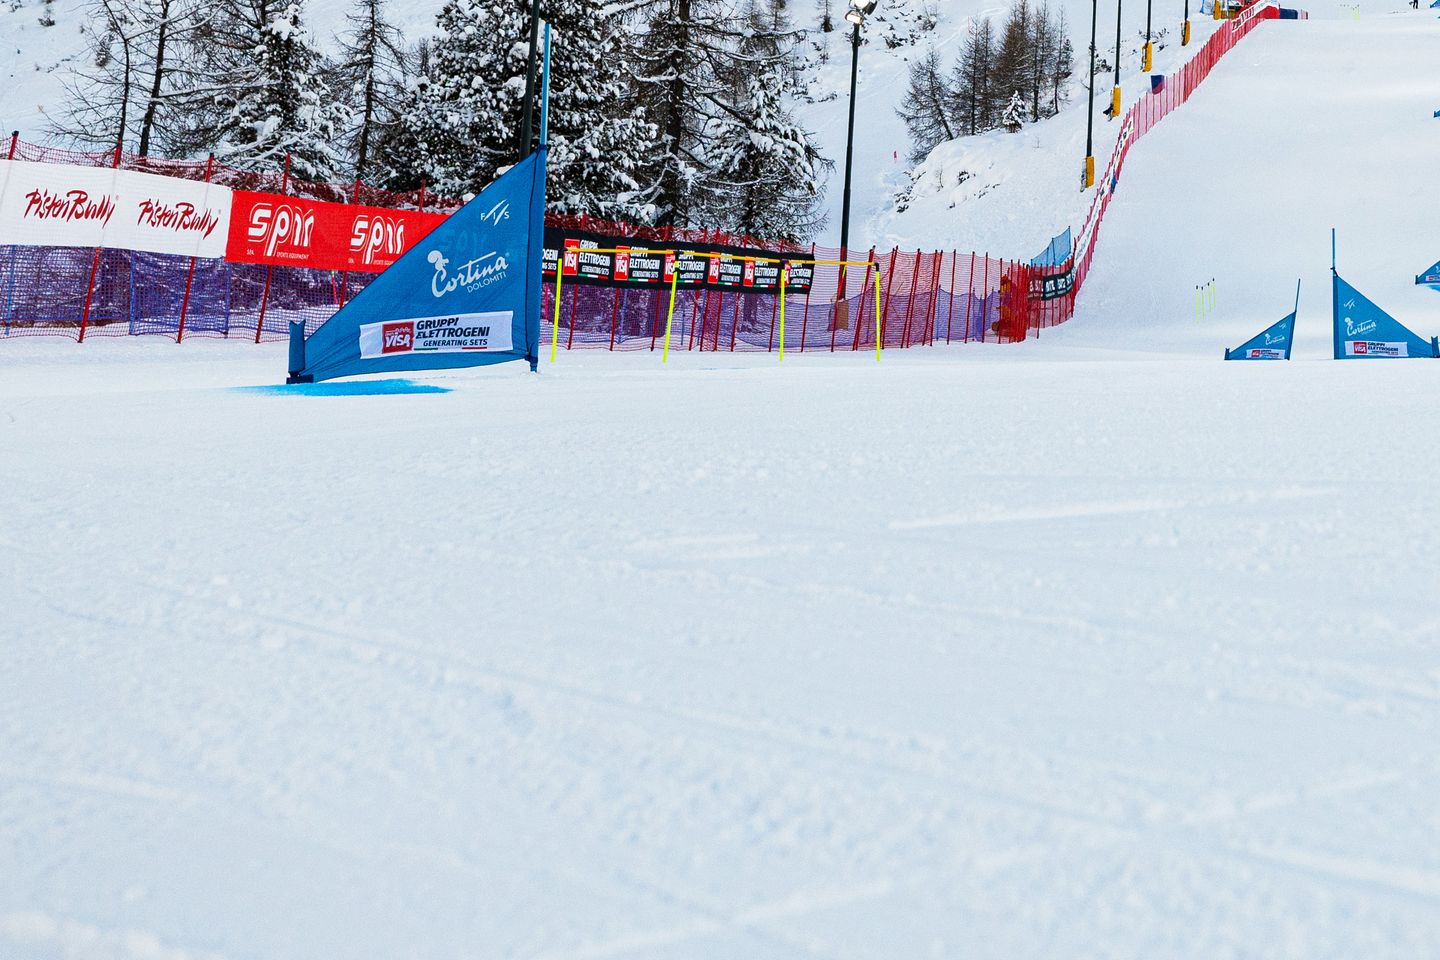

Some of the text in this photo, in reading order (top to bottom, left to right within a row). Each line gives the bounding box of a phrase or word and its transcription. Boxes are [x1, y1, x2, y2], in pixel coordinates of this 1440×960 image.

[24, 188, 115, 229] PistenBully
[138, 198, 219, 240] PistenBully
[578, 252, 611, 267] ELETTROGENI
[629, 258, 661, 270] ELETTROGENI
[431, 251, 509, 297] Cortina
[467, 272, 507, 293] DOLOMITI
[416, 317, 459, 330] GRUPPI
[385, 332, 411, 348] VISA
[415, 327, 490, 339] ELETTROGENI
[423, 338, 488, 347] GENERATING SETS
